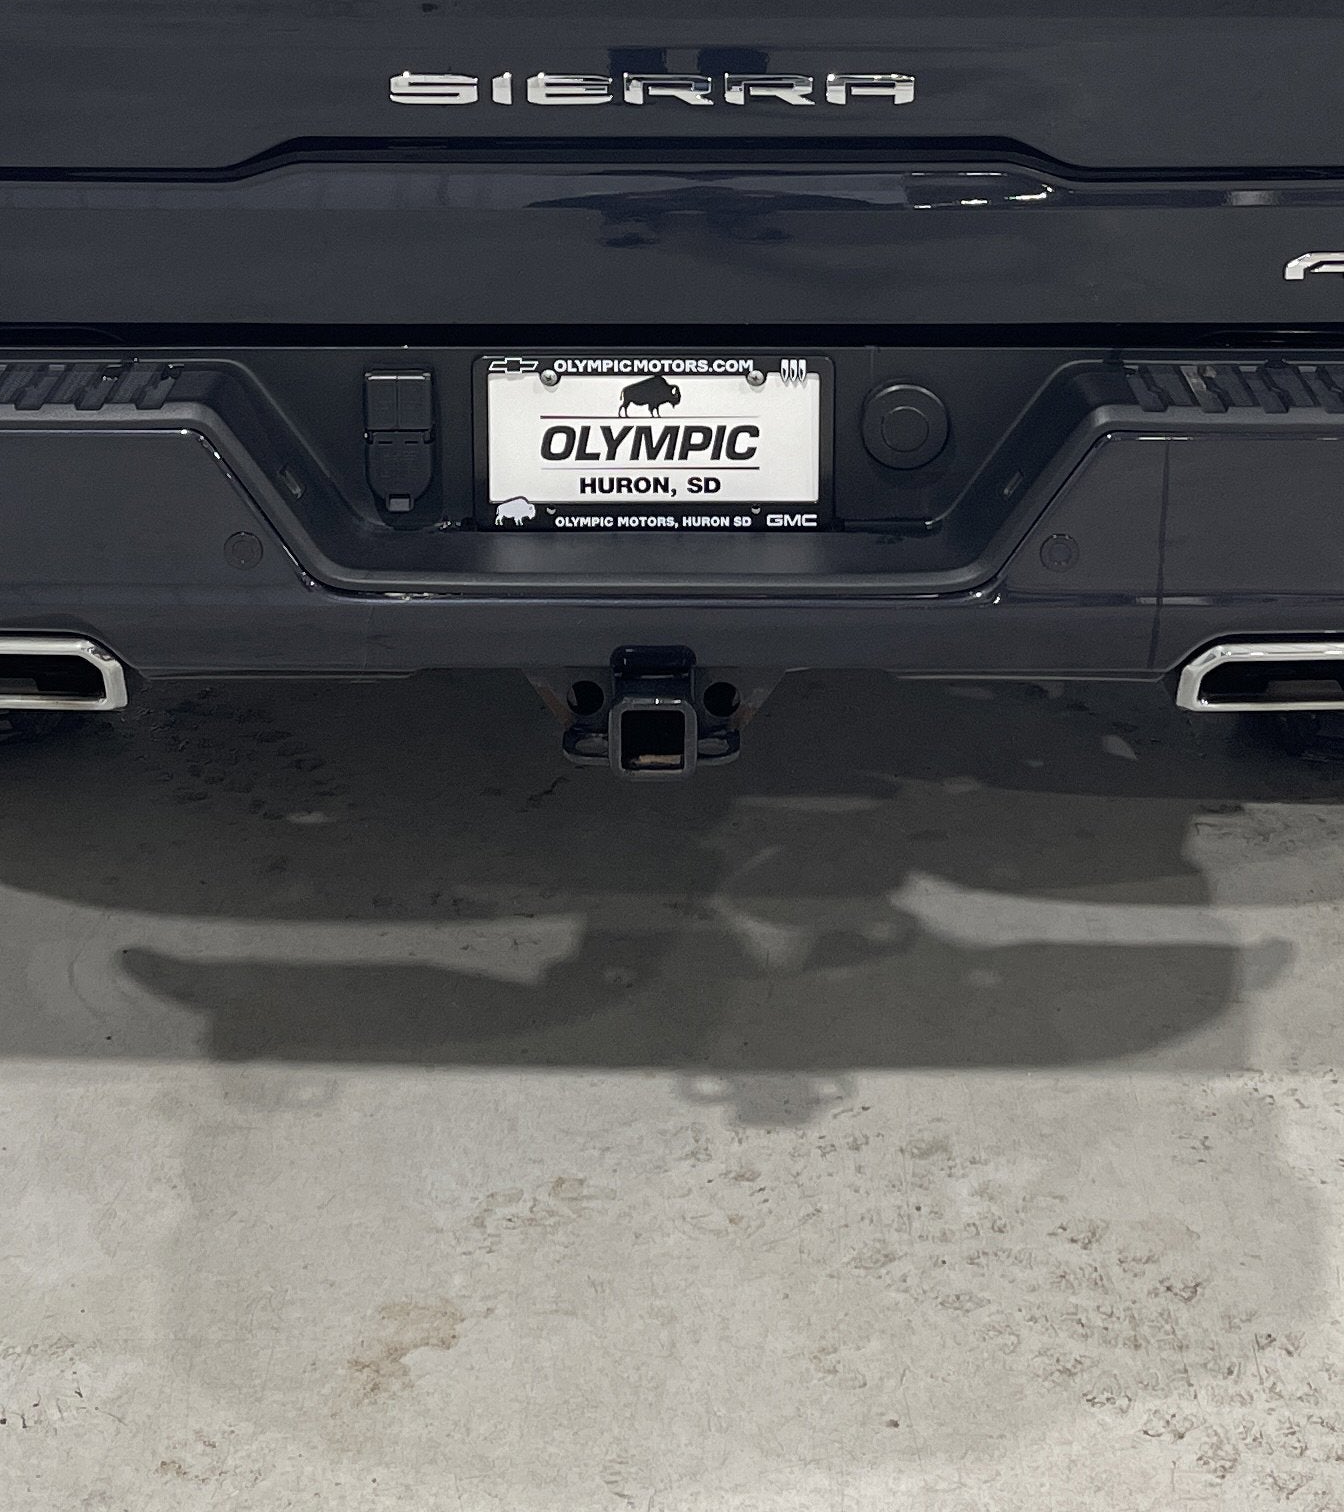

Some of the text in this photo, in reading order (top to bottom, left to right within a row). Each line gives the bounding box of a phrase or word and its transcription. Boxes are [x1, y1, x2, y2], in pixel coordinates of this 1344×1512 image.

[389, 72, 915, 105] SIERRA
[540, 425, 760, 461] OLYMPIC
[579, 477, 721, 497] HURON, SD
[555, 516, 752, 529] OLYMPIC MOTORS, HURON SD
[766, 514, 818, 527] GMC
